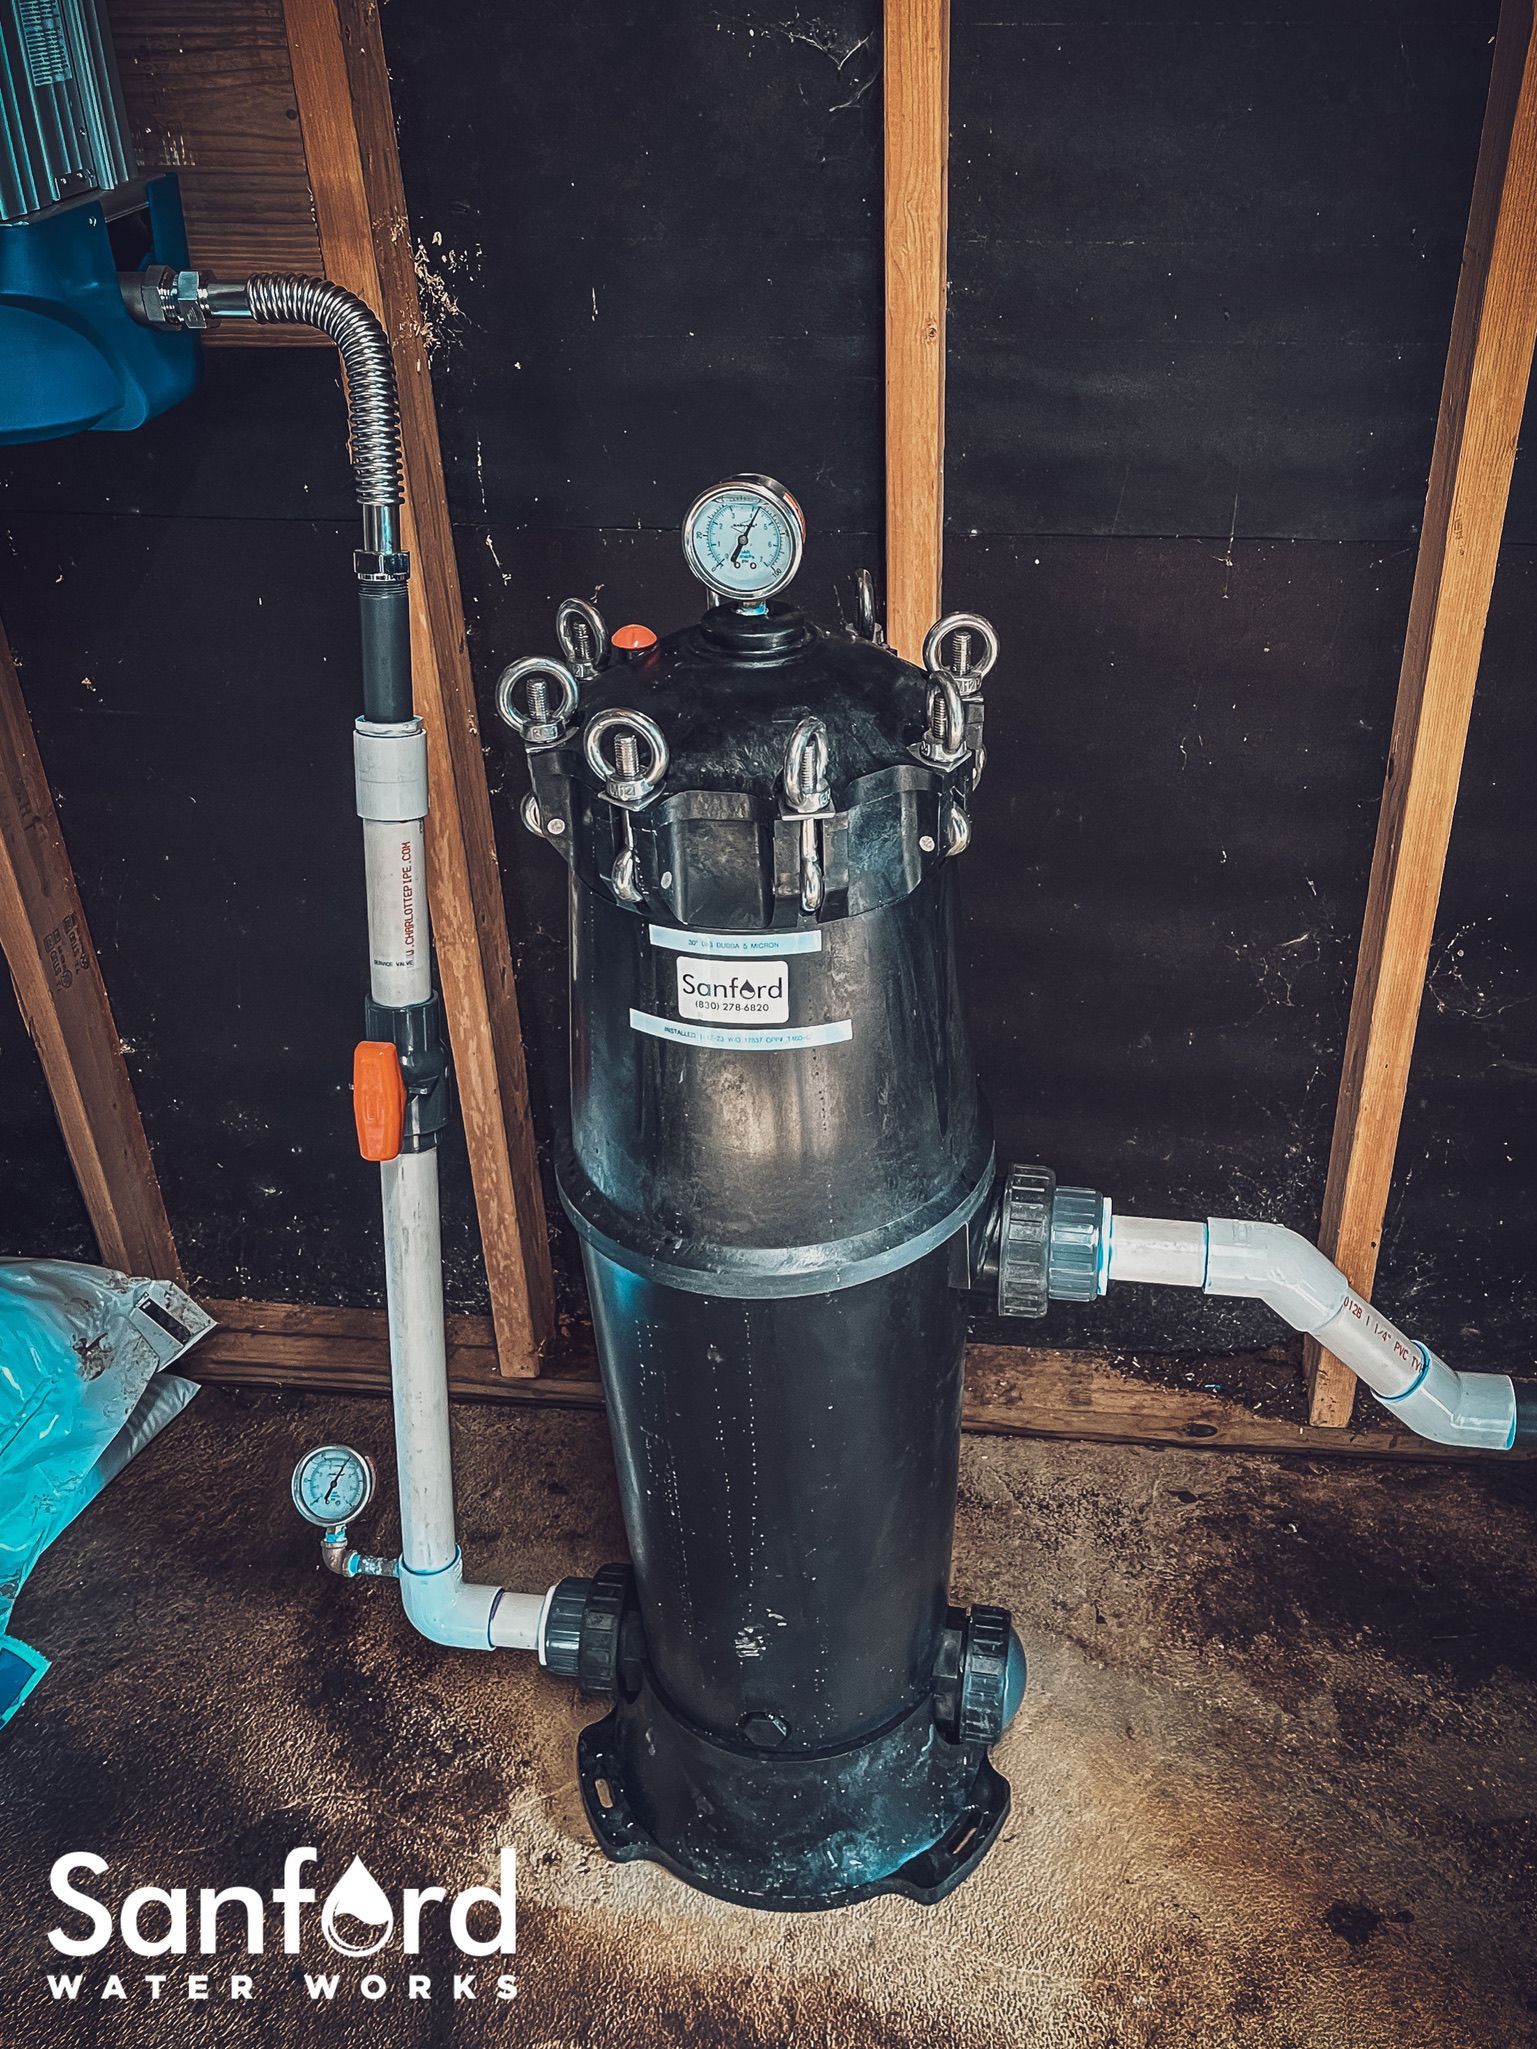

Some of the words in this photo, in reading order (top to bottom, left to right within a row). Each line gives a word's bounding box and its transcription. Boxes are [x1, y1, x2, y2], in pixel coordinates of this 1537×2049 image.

[682, 973, 783, 1000] Sanford
[695, 1000, 720, 1011] (830)
[722, 1003, 769, 1012] 278-6820
[664, 1026, 697, 1038] INSTALLED
[1393, 1341, 1409, 1361] PVC
